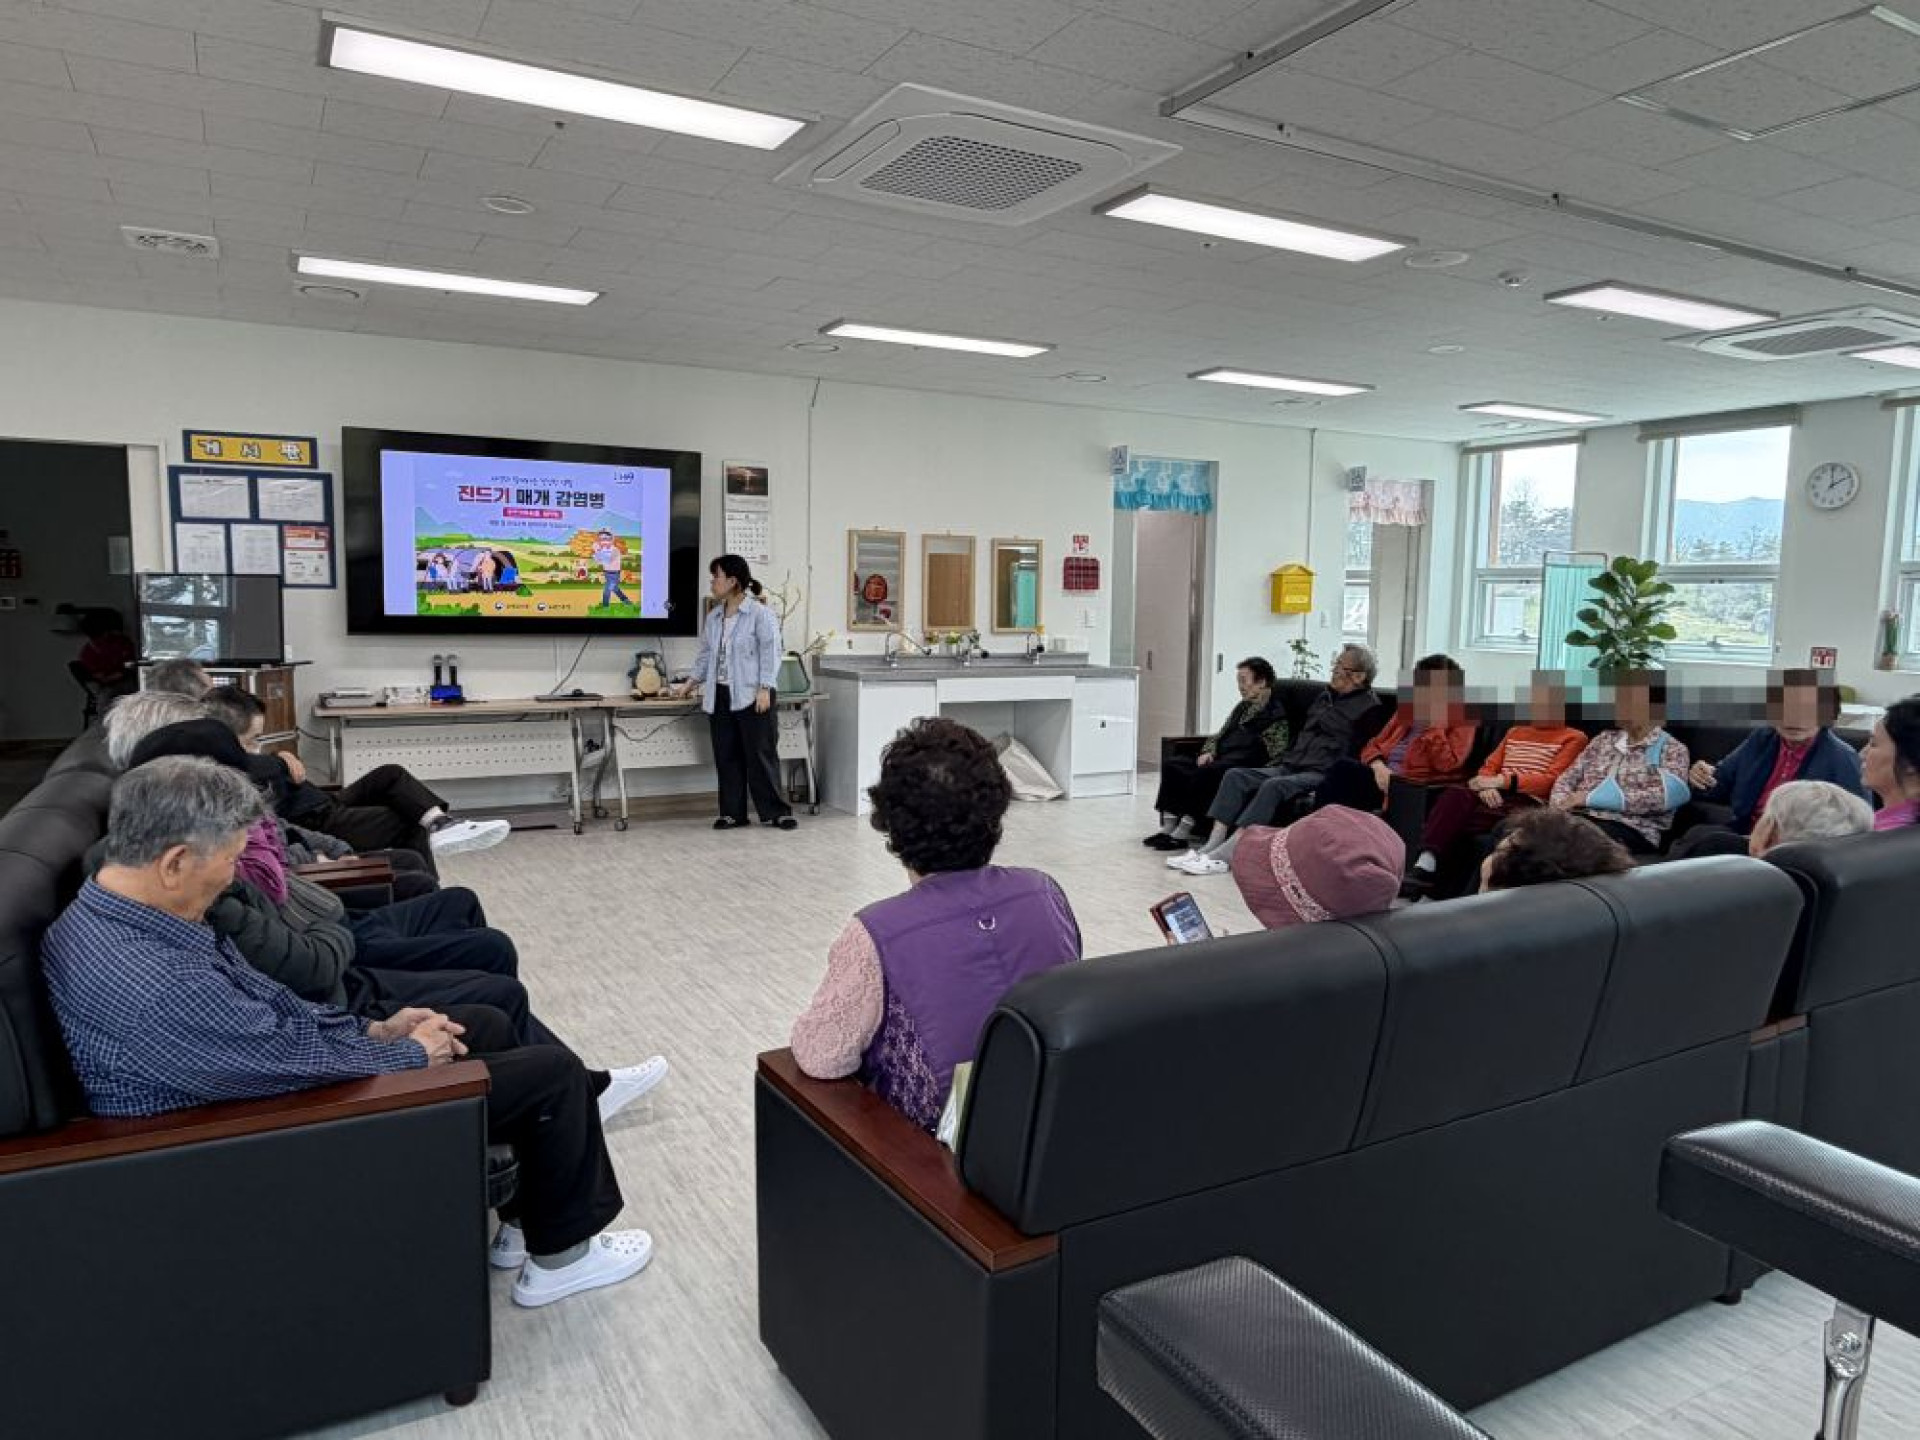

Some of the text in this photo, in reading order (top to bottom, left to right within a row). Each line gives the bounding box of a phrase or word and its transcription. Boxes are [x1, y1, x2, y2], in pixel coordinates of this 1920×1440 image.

[457, 485, 605, 508] 진드기 매개 감염병
